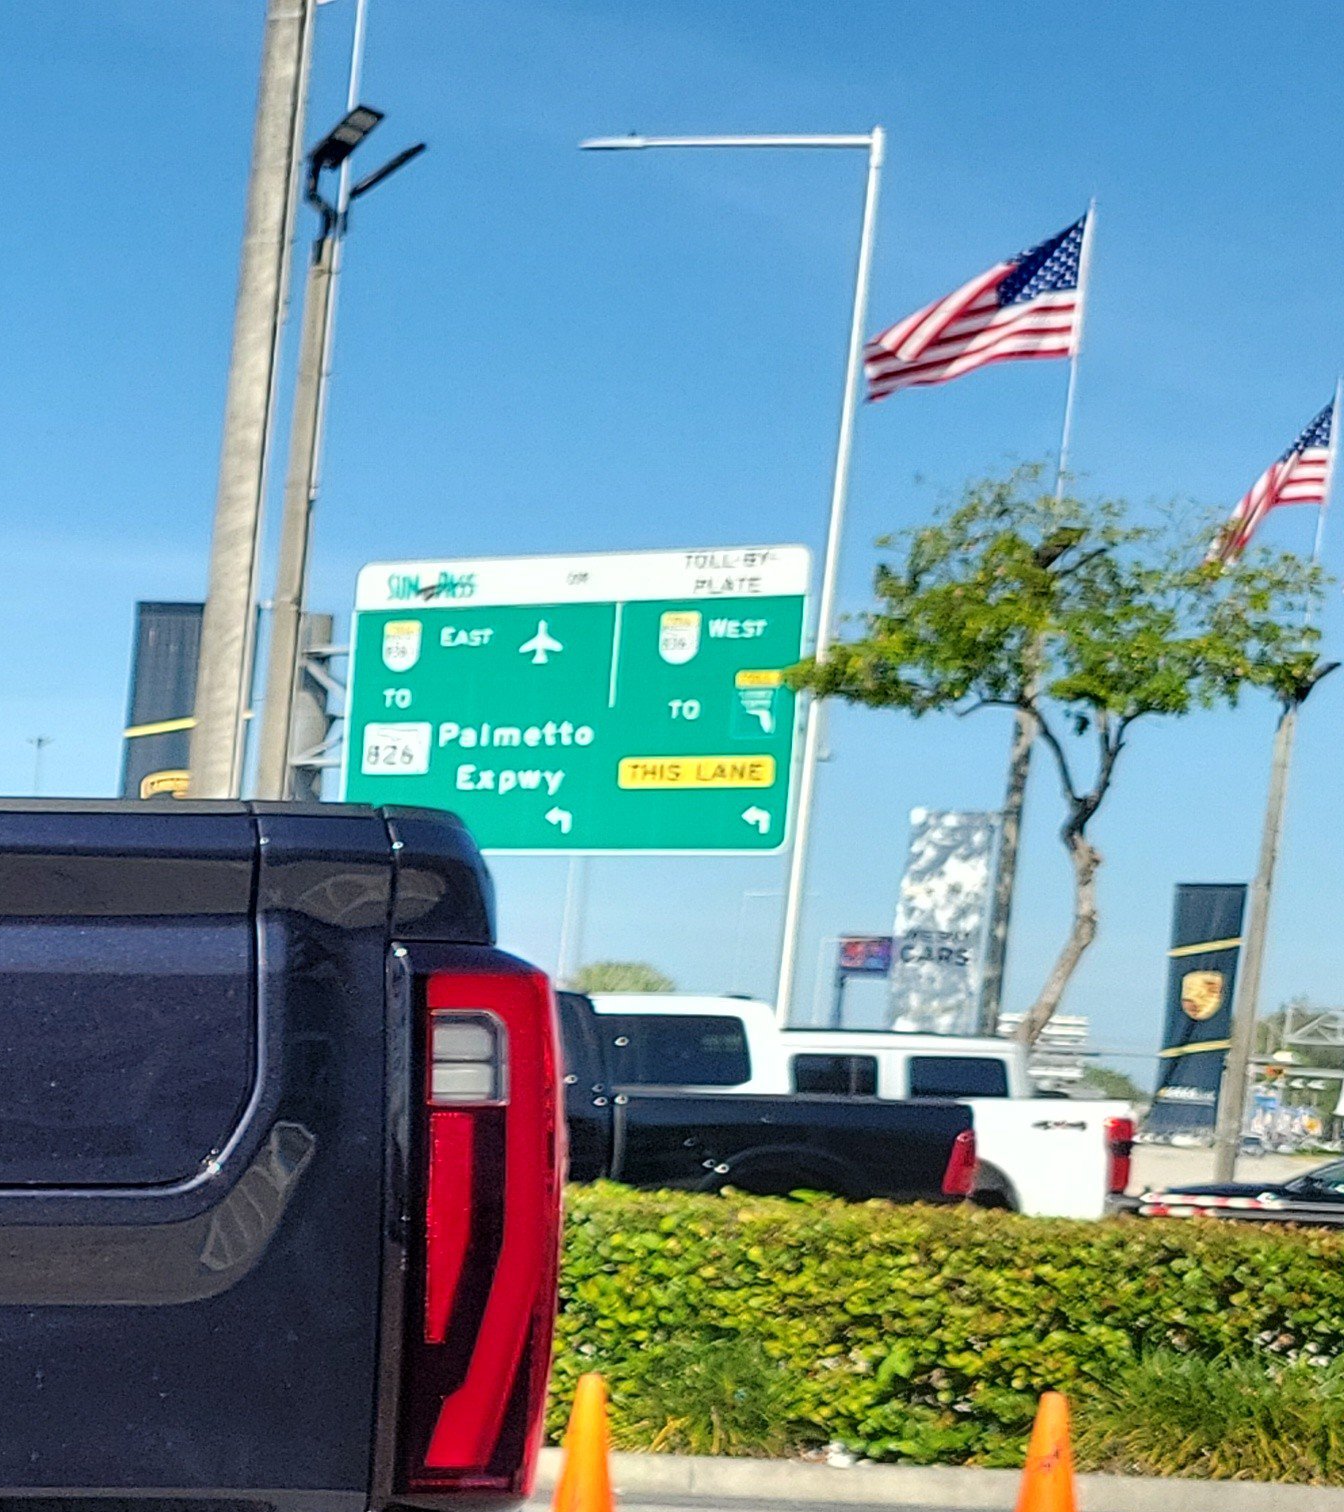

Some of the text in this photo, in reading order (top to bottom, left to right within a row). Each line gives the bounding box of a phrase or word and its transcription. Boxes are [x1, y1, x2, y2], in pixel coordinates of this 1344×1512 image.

[694, 576, 762, 595] PLATE
[440, 626, 494, 647] EAST
[708, 618, 768, 639] WEST
[383, 688, 412, 709] TO
[668, 698, 701, 720] TO
[438, 720, 595, 748] Palmetto
[366, 745, 415, 766] 826
[455, 763, 566, 796] Expwy
[628, 762, 764, 782] THIS LANE
